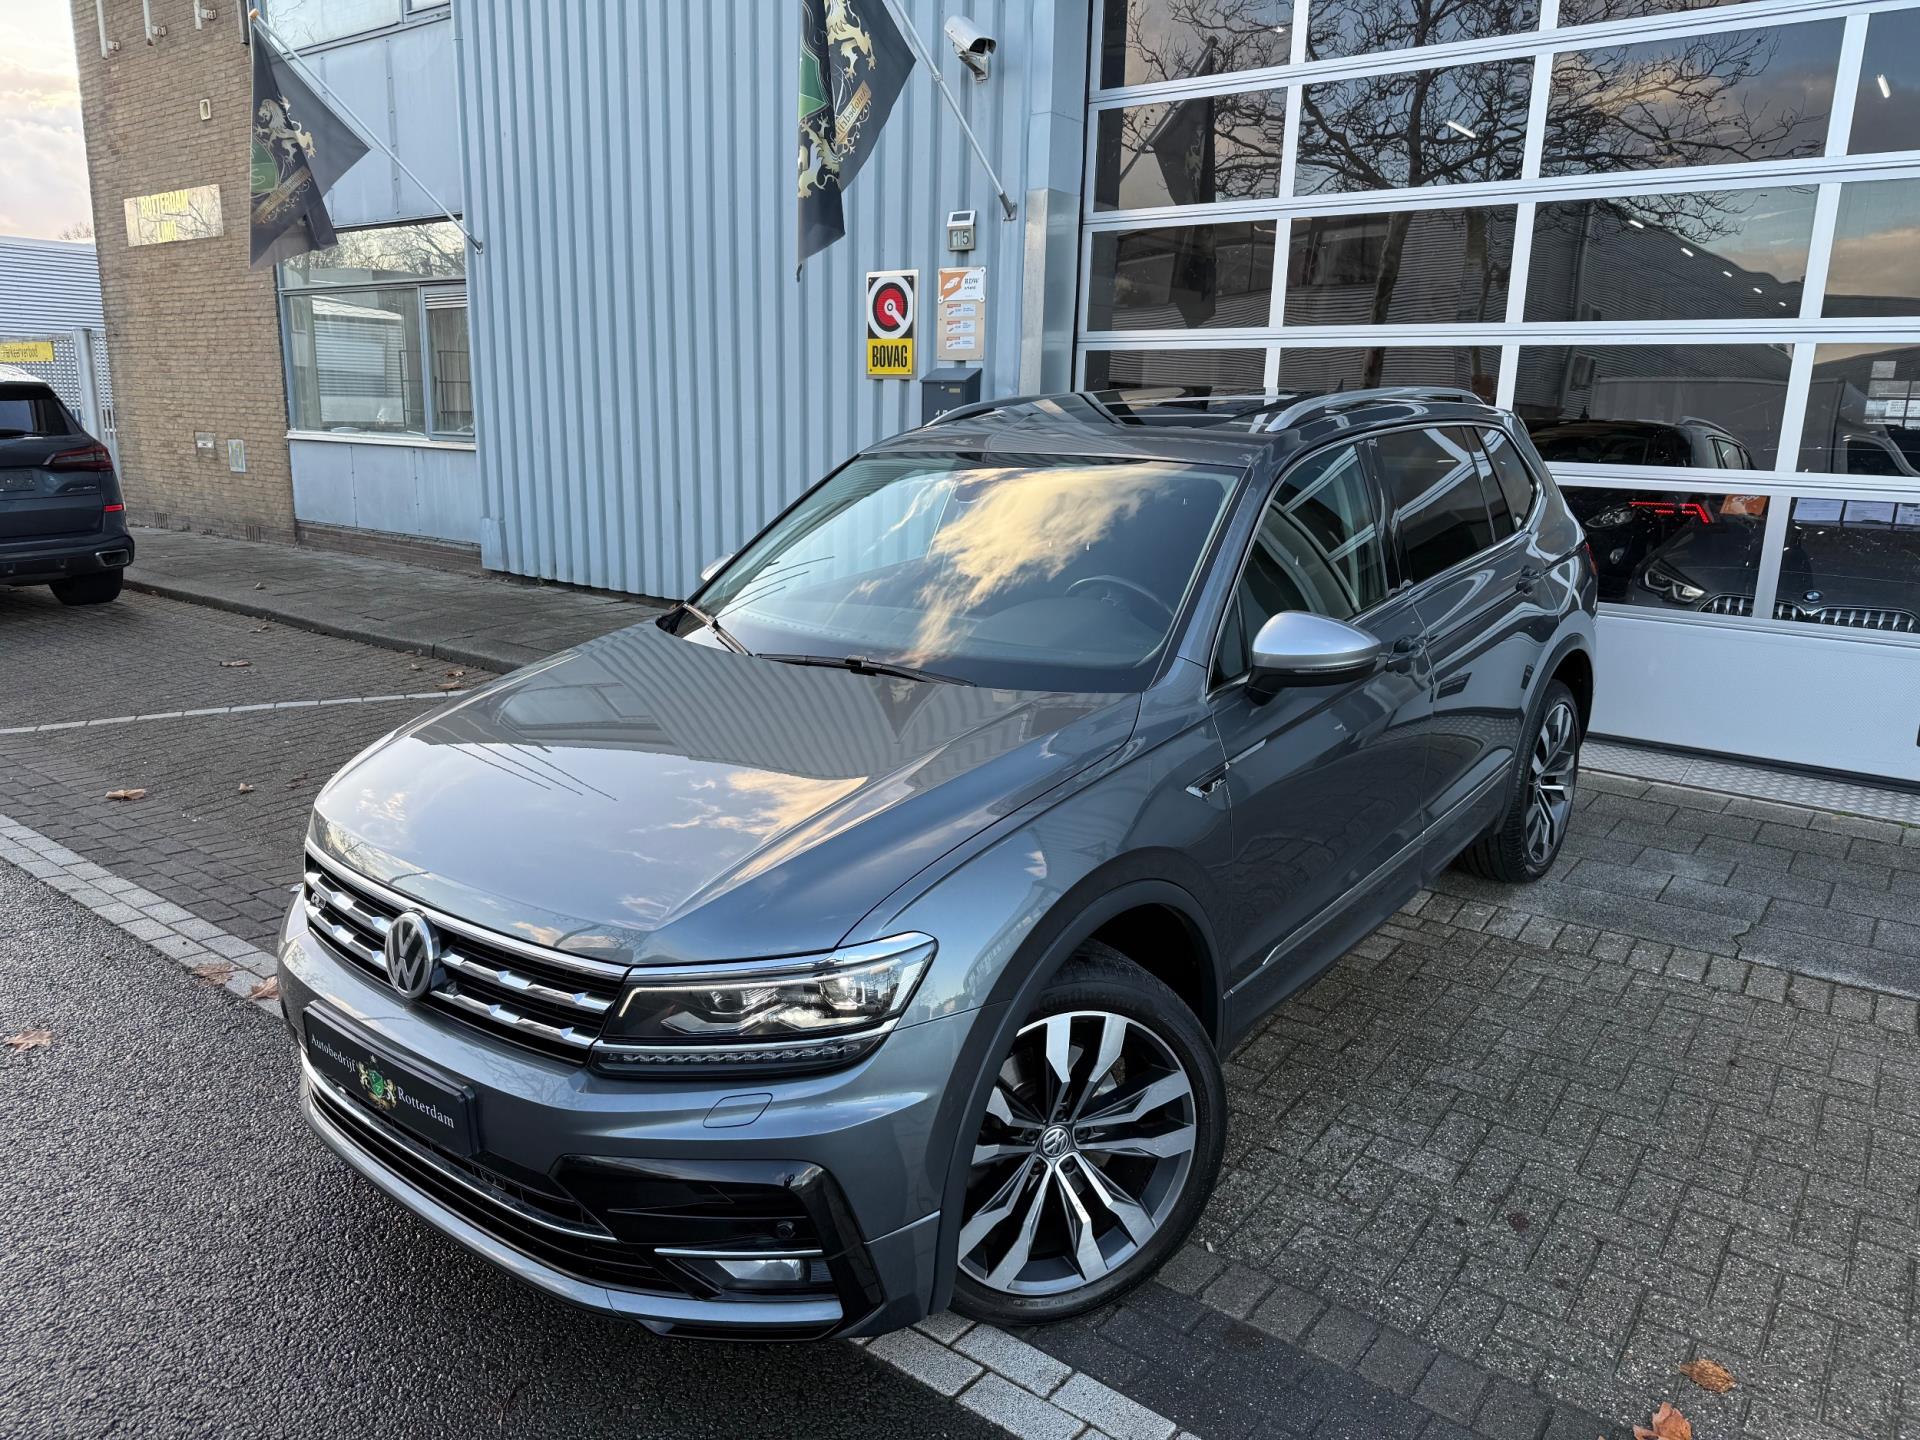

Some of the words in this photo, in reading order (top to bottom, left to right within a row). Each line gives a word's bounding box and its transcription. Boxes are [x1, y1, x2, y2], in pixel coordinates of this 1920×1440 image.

[954, 231, 969, 246] 15
[872, 344, 908, 368] BOVAG
[311, 1034, 355, 1073] Autobedrijf
[397, 1086, 455, 1129] Rotterdam
